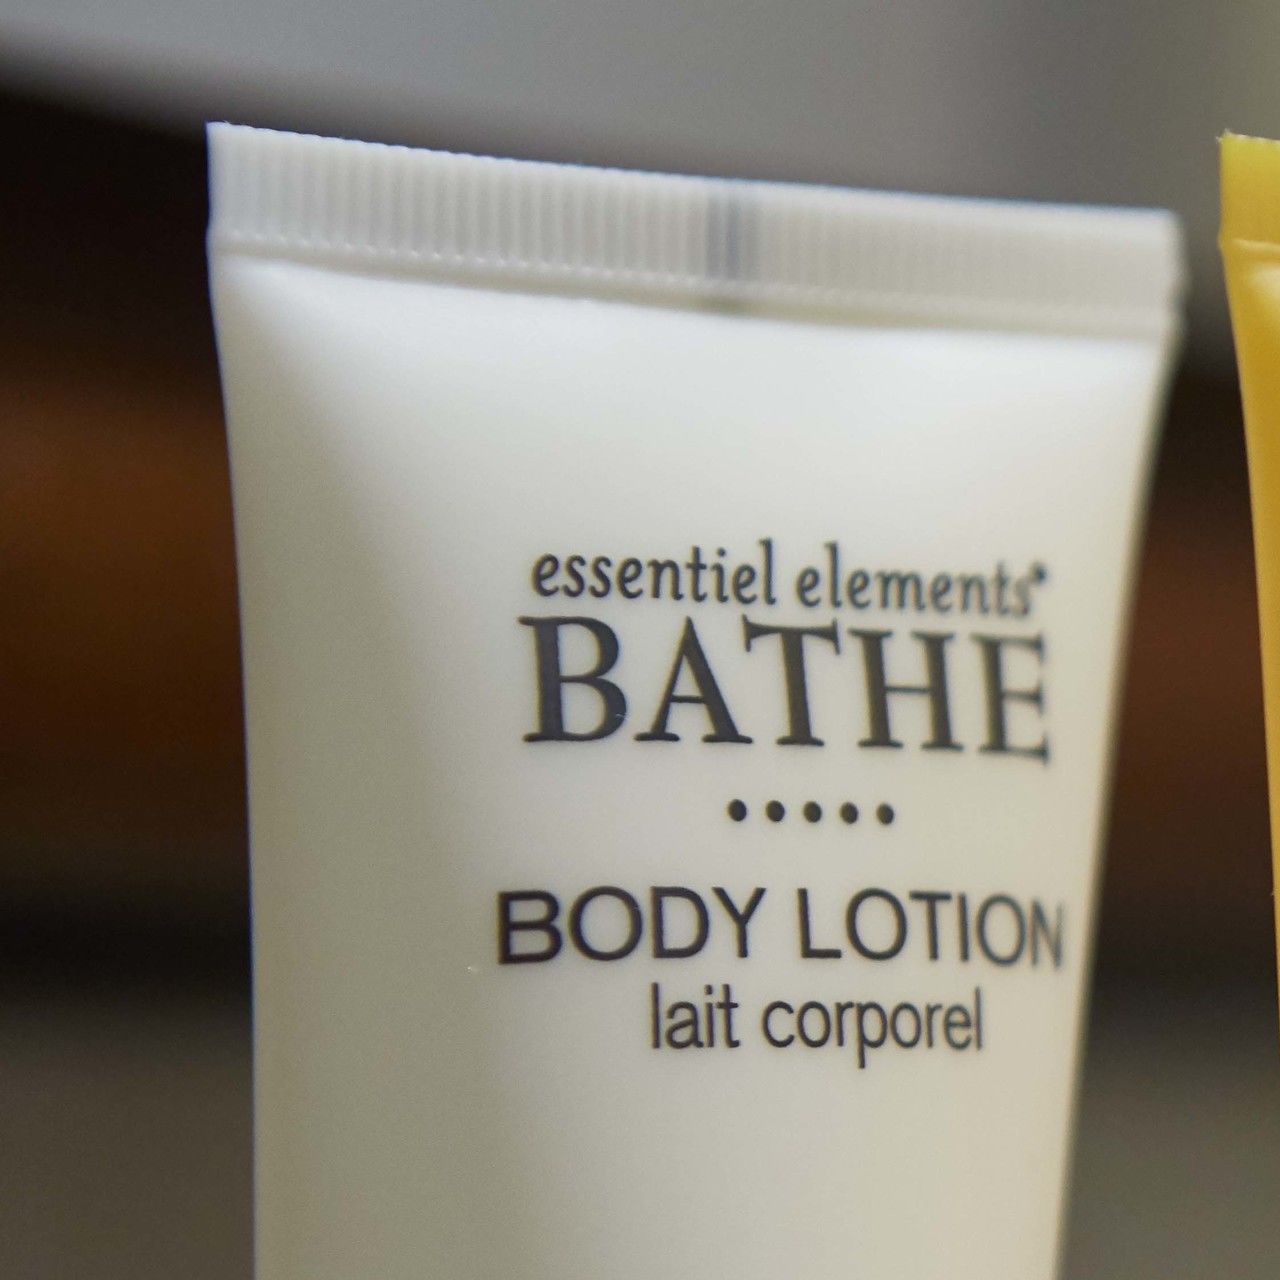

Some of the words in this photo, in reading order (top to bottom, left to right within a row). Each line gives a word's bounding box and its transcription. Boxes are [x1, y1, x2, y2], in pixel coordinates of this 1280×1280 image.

[531, 538, 777, 605] essentiel
[517, 613, 1051, 766] BATHE
[498, 885, 767, 965] BODY
[798, 887, 1063, 969] LOTION
[650, 982, 740, 1049] lait
[762, 986, 983, 1069] corporel
